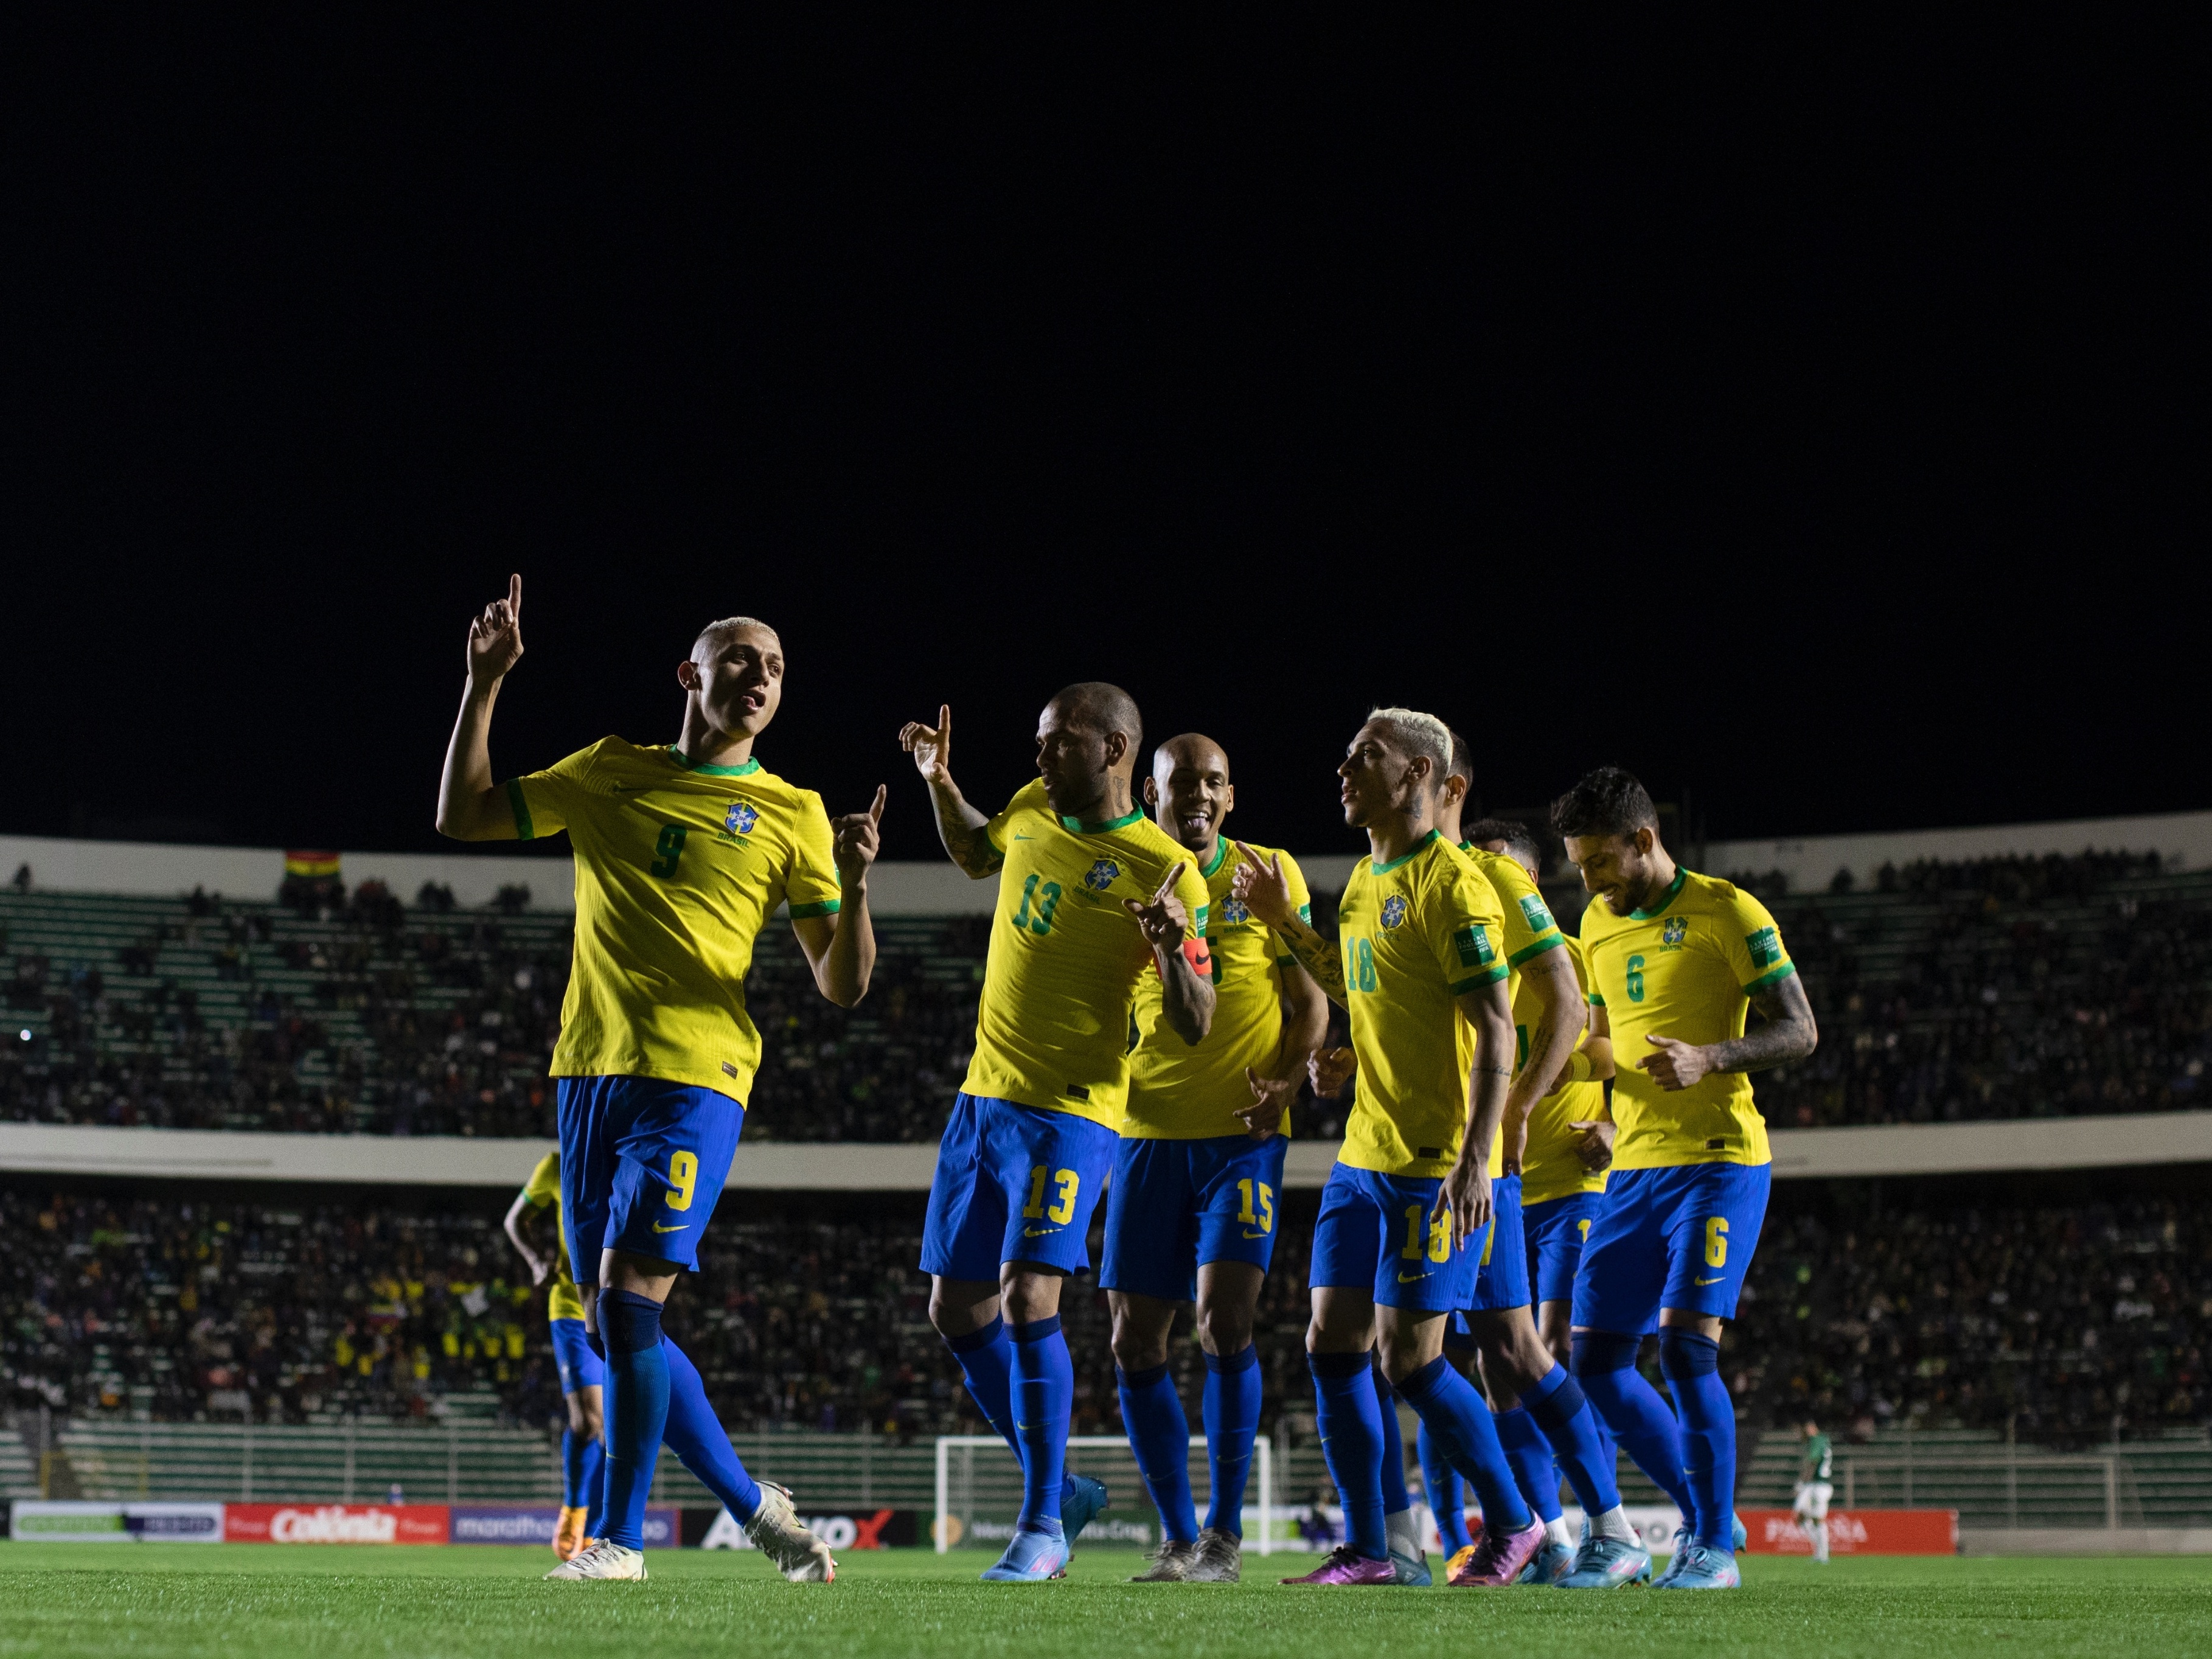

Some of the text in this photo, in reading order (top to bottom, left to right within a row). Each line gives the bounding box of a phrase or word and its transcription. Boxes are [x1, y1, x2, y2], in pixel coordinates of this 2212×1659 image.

[650, 824, 686, 879] 9
[717, 832, 749, 848] BRASIL
[1011, 873, 1062, 936] 13
[1074, 885, 1100, 905] BRASIL
[1347, 936, 1377, 992] 18
[1626, 955, 1645, 1003] 6
[664, 1150, 699, 1211] 9
[1023, 1164, 1080, 1225] 13
[1237, 1178, 1273, 1234] 15
[1402, 1205, 1452, 1264] 18
[1705, 1217, 1730, 1268] 6
